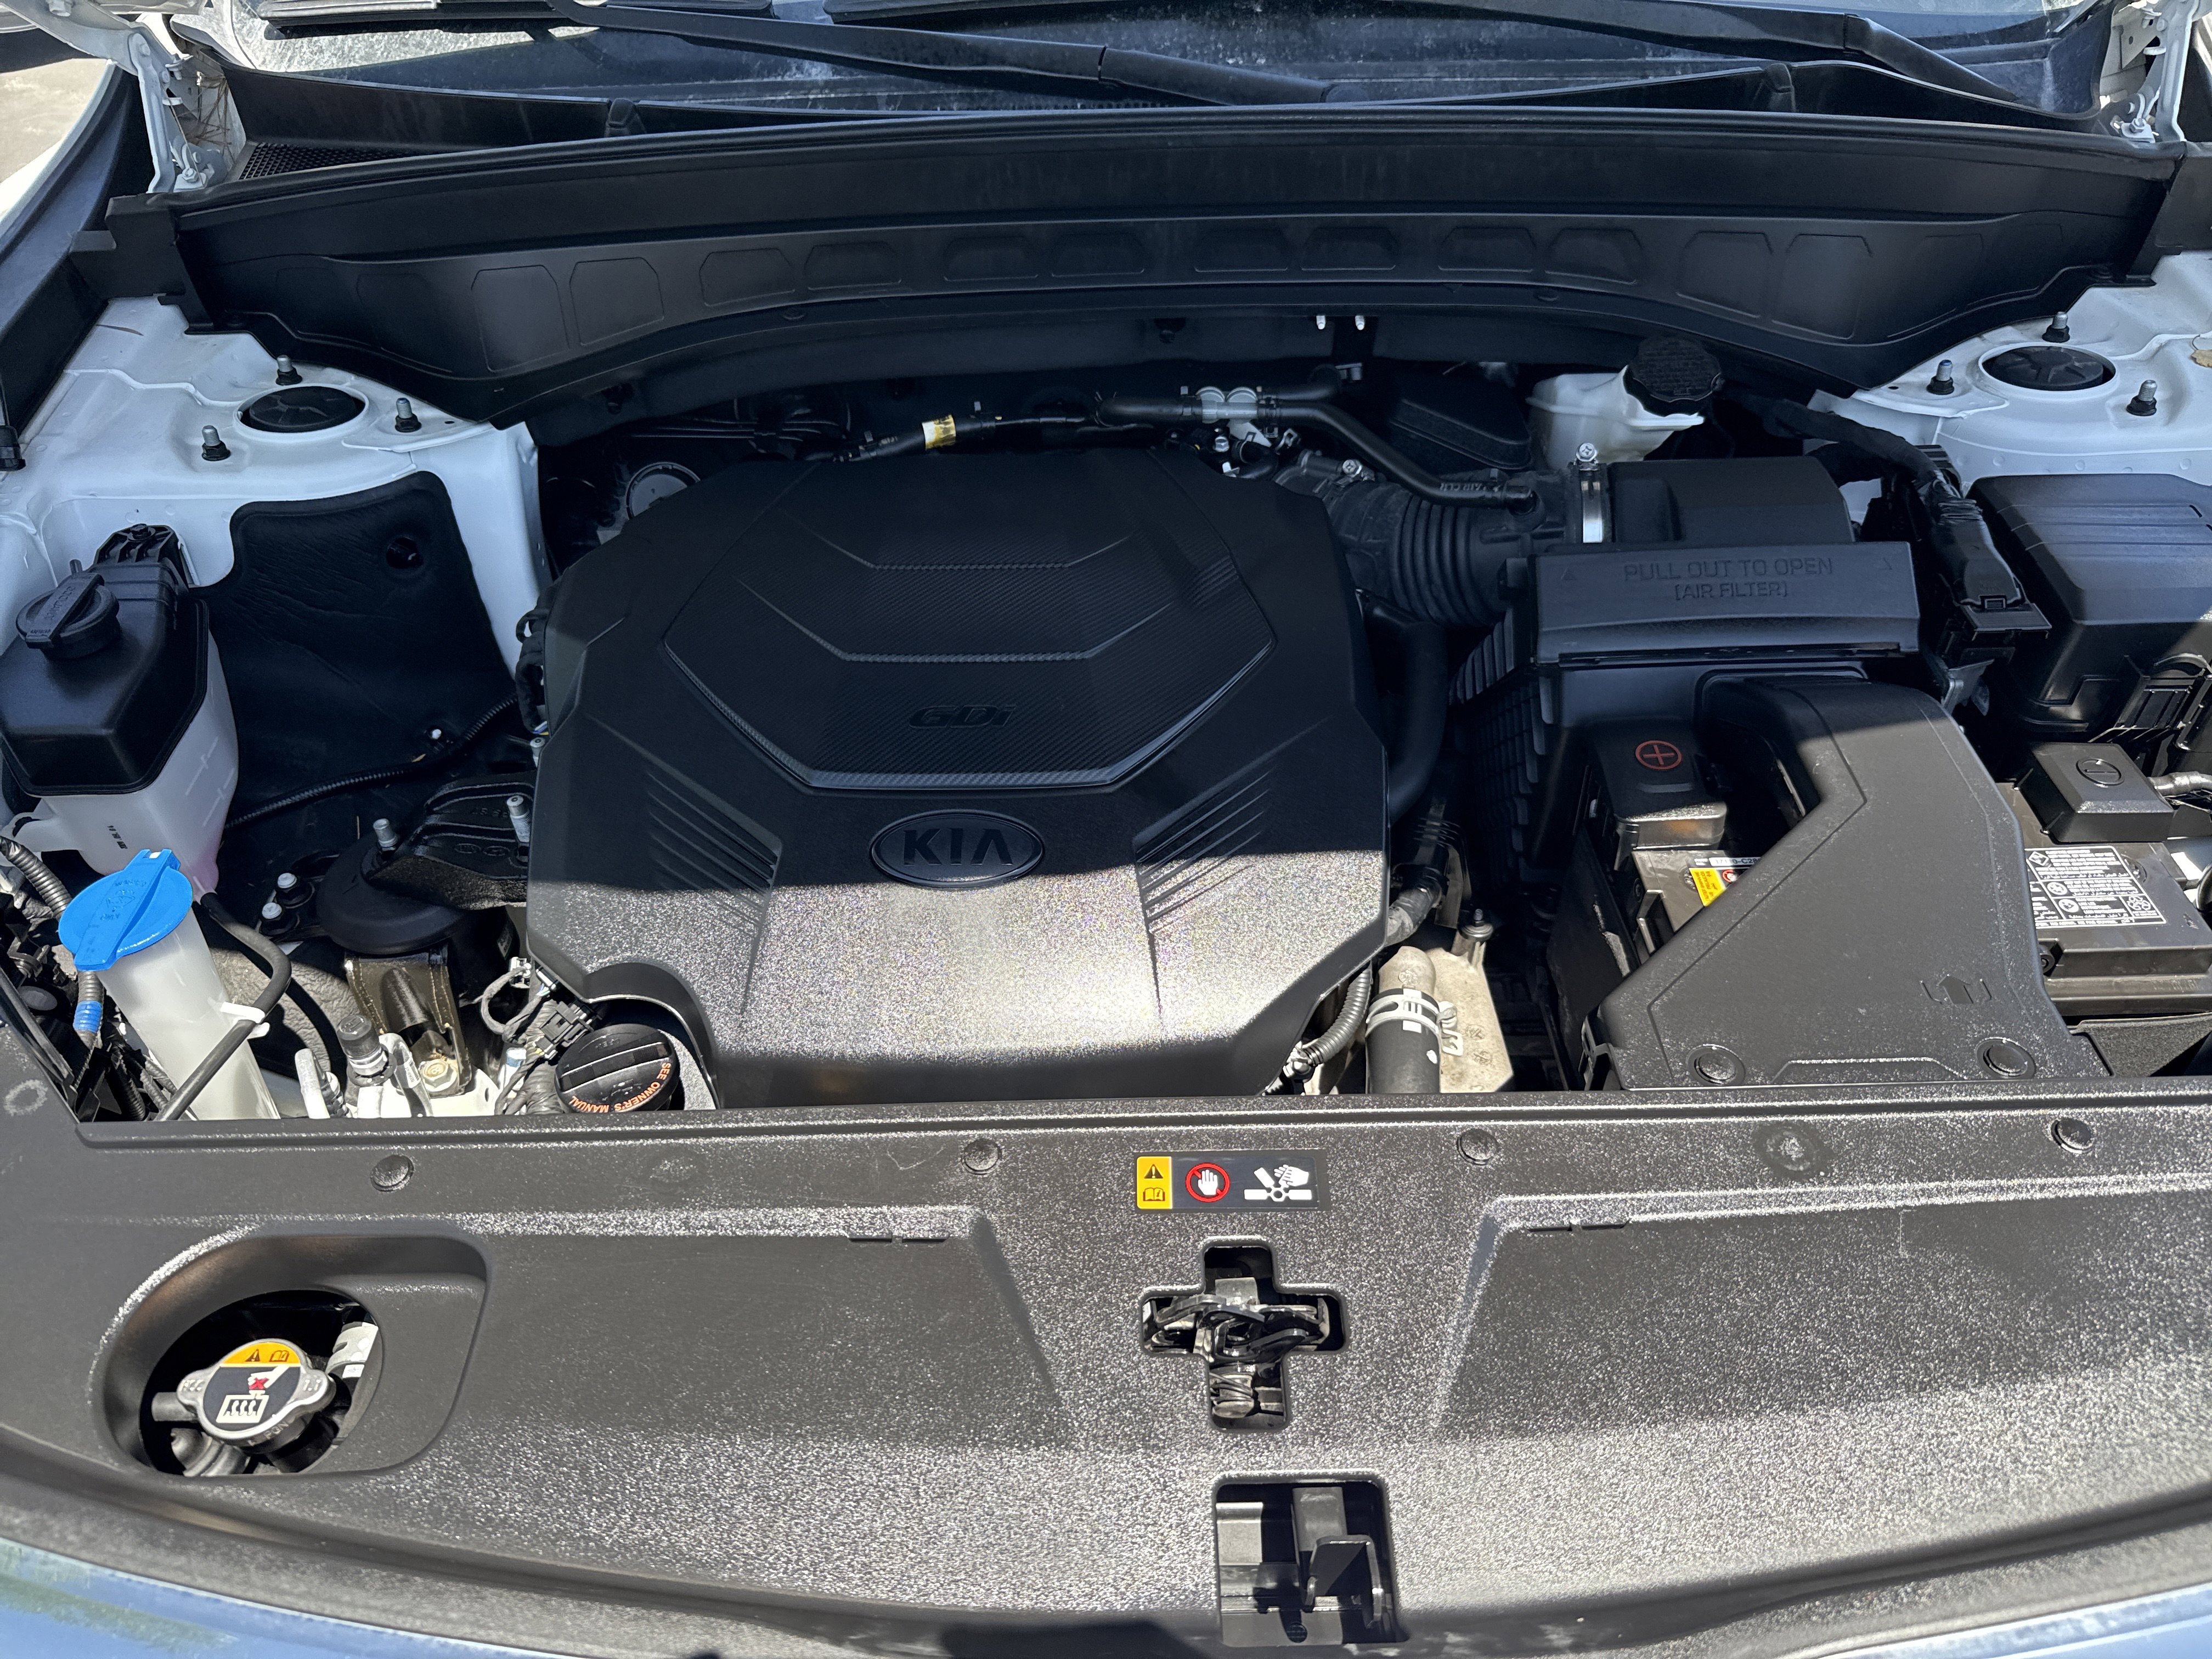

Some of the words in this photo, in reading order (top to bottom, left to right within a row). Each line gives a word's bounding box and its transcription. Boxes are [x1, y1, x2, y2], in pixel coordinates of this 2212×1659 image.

[1623, 562, 1681, 582] PULL
[1687, 560, 1732, 579] OUT
[1737, 558, 1767, 577] TO
[1773, 557, 1833, 575] OPEN
[903, 827, 1015, 867] KIA
[657, 1062, 672, 1081] SEE
[568, 1095, 610, 1113] MANUAL
[614, 1081, 660, 1111] OWNER'S
